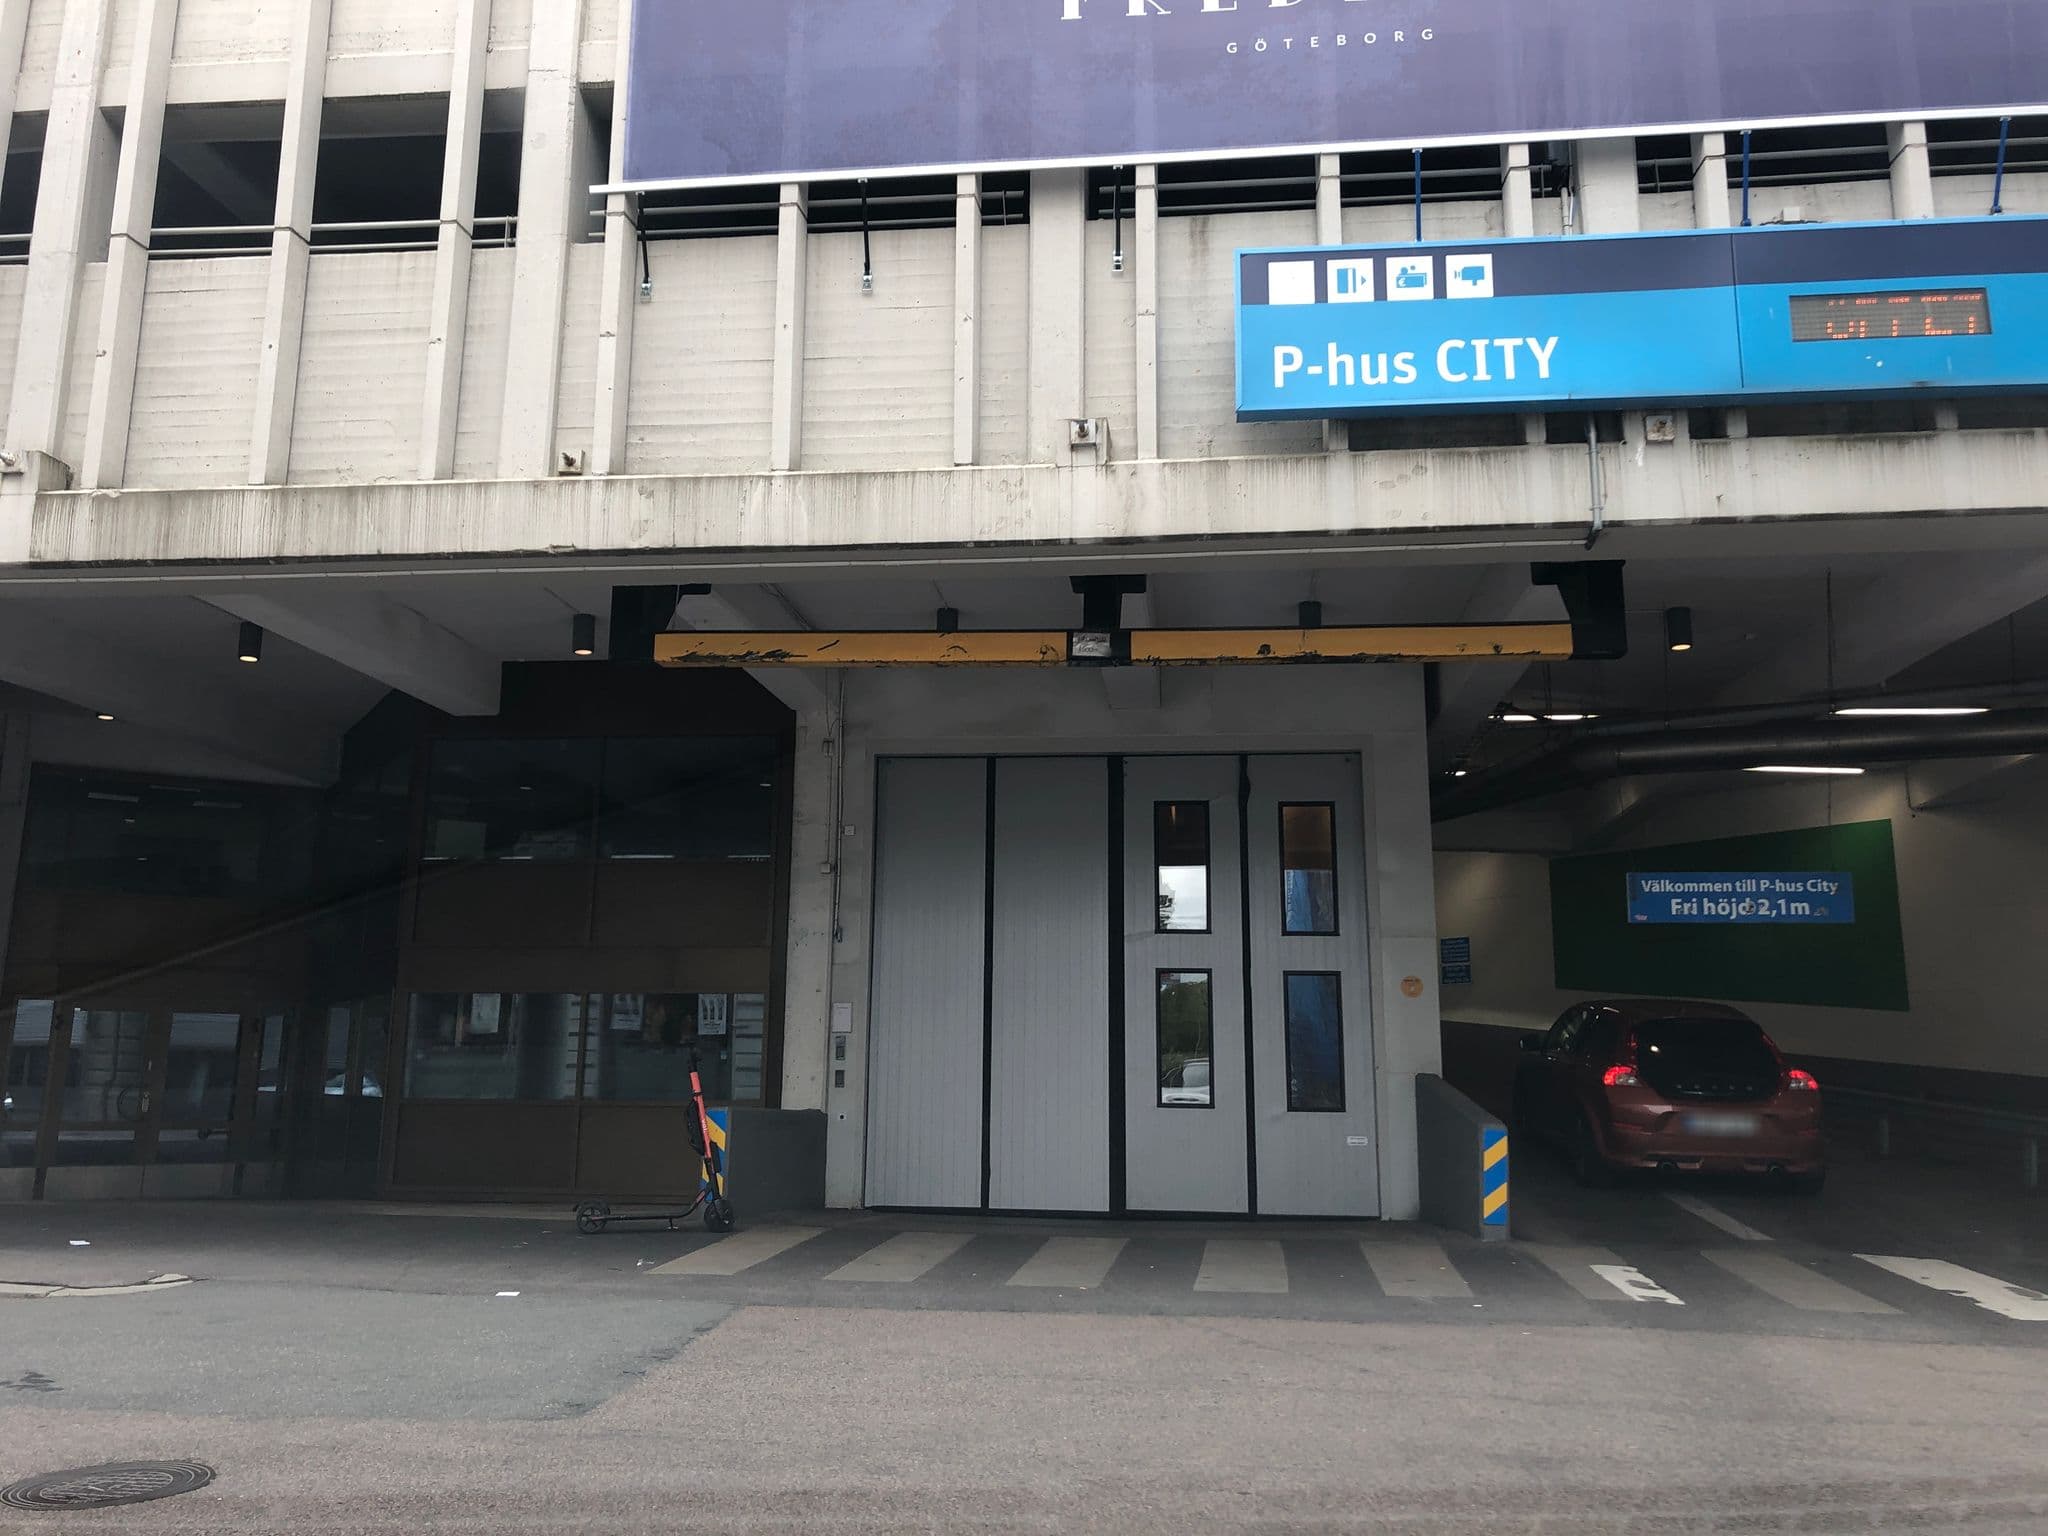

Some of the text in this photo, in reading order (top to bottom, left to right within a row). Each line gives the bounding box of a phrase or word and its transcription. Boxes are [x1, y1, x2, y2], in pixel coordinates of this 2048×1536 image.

[1226, 28, 1434, 54] GÖTEBORG
[1272, 335, 1559, 389] P-hus CITY
[1641, 878, 1839, 896] Välkommen till P-hus City
[1671, 897, 1698, 916] Fri
